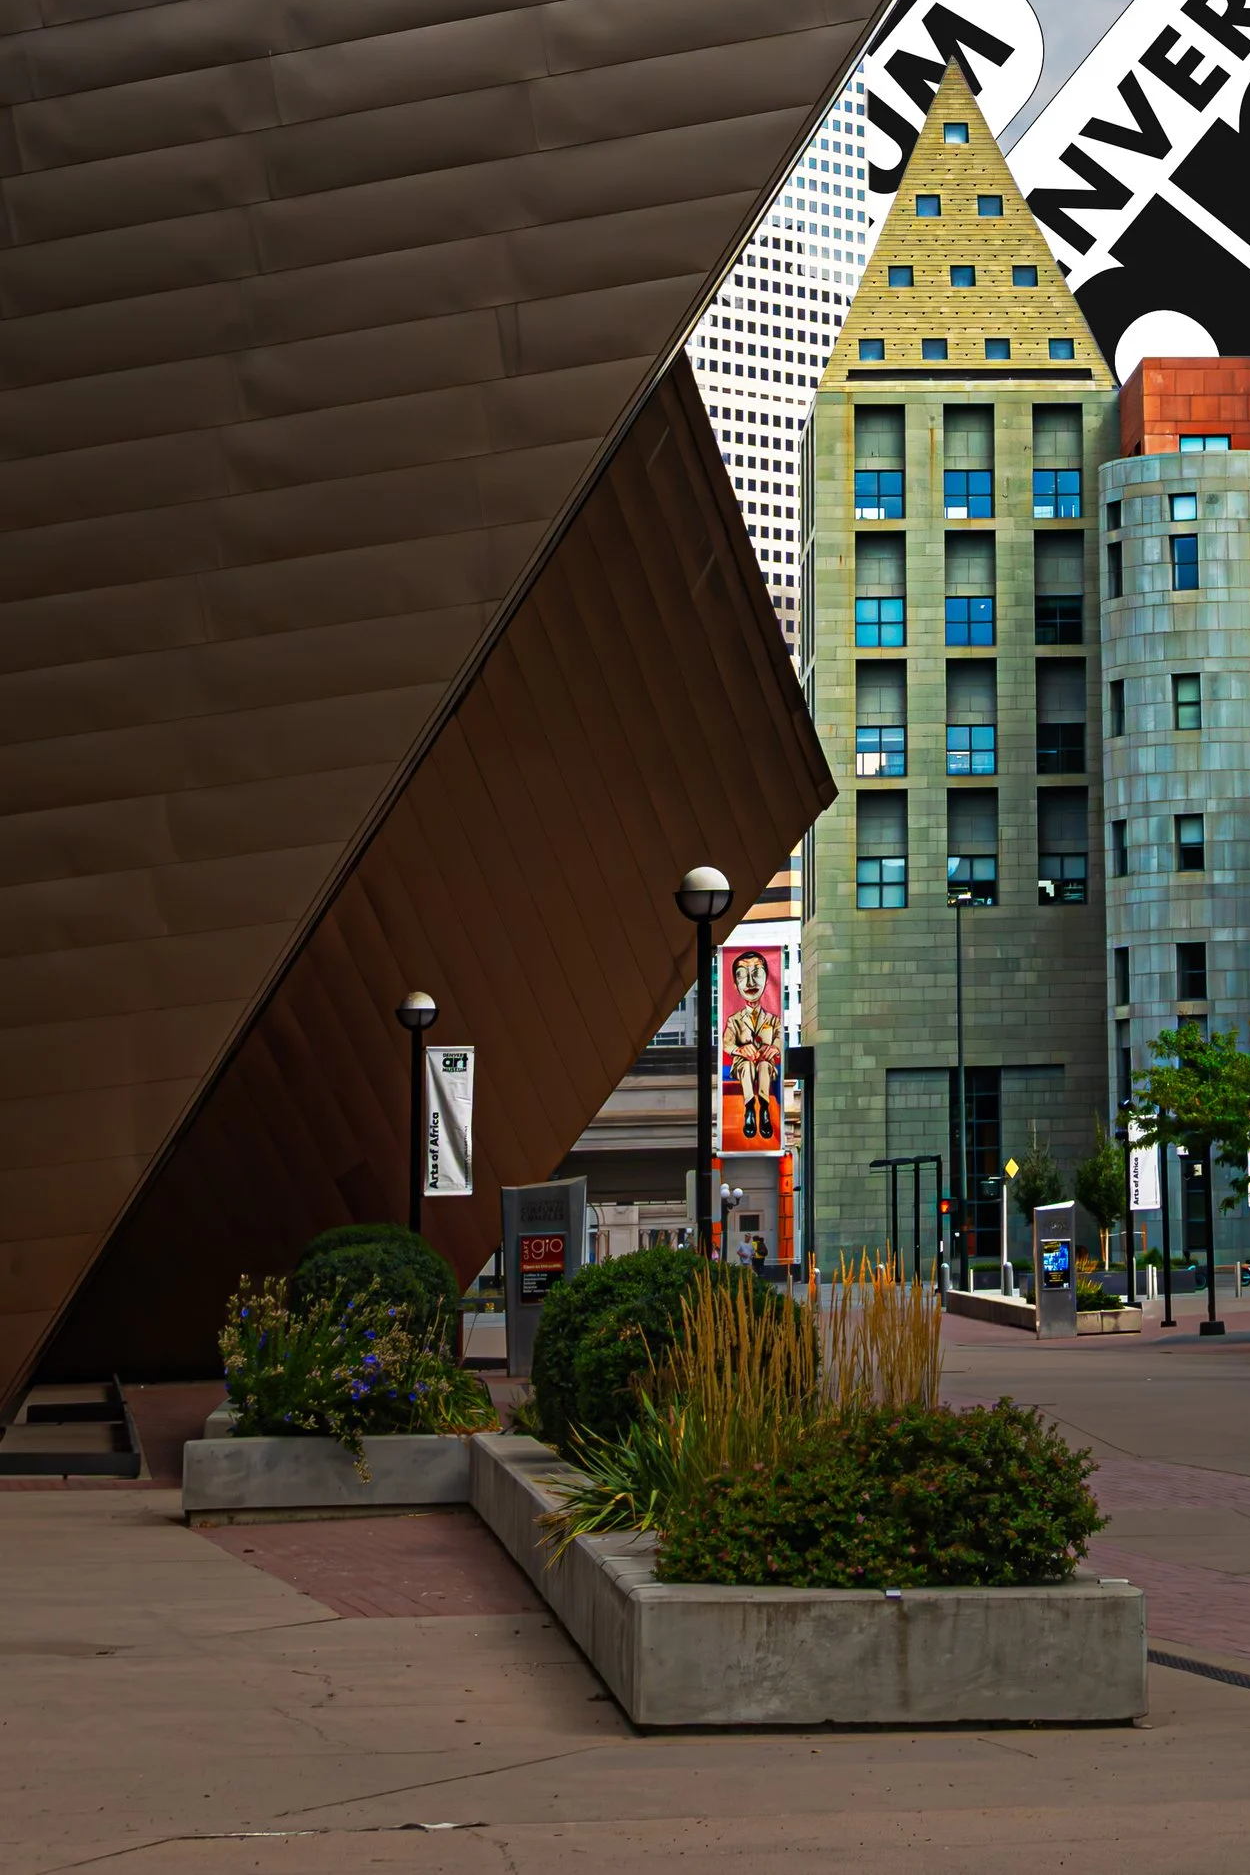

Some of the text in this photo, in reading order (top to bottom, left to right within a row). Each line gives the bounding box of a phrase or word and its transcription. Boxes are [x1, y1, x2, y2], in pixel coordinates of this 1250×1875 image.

[442, 1053, 468, 1067] art
[429, 1112, 440, 1190] Arts of Africa
[1133, 1180, 1139, 1188] of
[531, 1238, 563, 1260] gio
